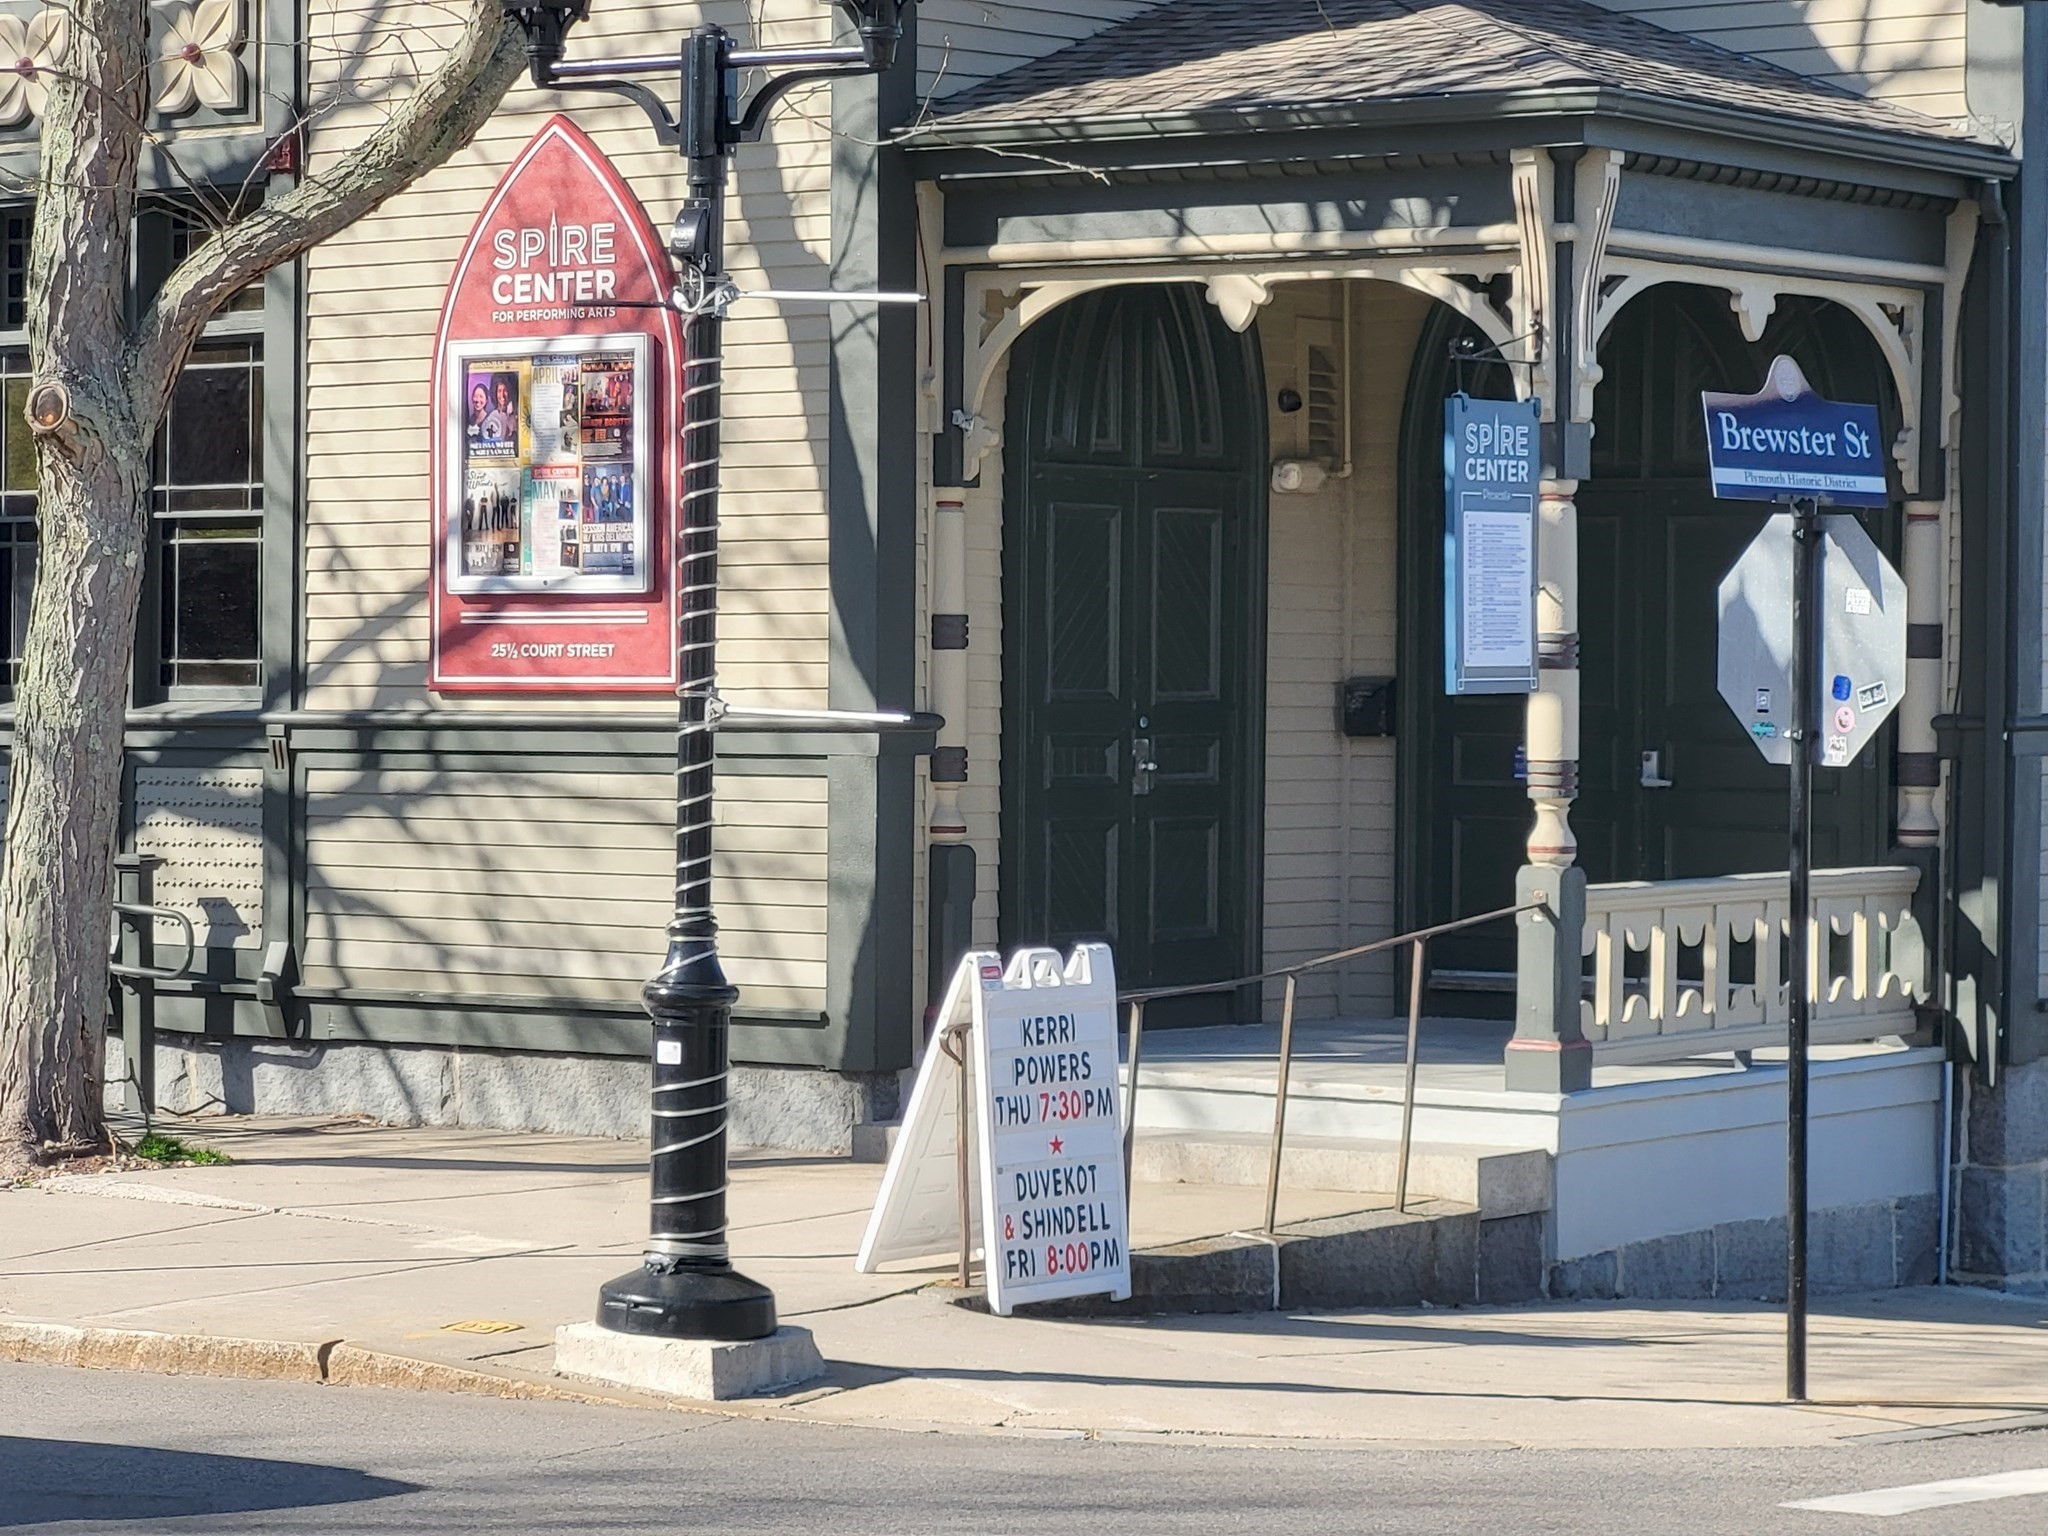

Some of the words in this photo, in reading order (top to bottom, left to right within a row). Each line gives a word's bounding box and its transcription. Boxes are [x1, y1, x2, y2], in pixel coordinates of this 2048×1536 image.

[493, 209, 616, 269] SPIRE
[492, 269, 616, 305] CENTER
[492, 310, 514, 323] FOR
[516, 307, 586, 322] PERFORMING
[588, 305, 616, 318] ARTS
[532, 366, 560, 385] APRIL
[1465, 412, 1529, 456] SPIRE
[1717, 412, 1836, 457] Brewster
[1843, 421, 1872, 459] St
[1465, 457, 1529, 482] CENTER
[1744, 471, 1785, 486] Plymouth
[1787, 473, 1822, 487] Historic
[1824, 476, 1857, 489] District
[532, 480, 557, 499] MAY
[521, 644, 564, 658] COURT
[566, 643, 615, 658] STREET
[1022, 1014, 1076, 1047] KERRI
[1014, 1051, 1092, 1086] POWERS
[995, 1094, 1031, 1126] THU
[1040, 1087, 1113, 1122] 7:30PM
[1015, 1164, 1097, 1201] DUVEKOT
[1004, 1214, 1015, 1240] &
[1022, 1202, 1110, 1240] SHINDELL
[1007, 1249, 1036, 1280] FRI
[1047, 1238, 1119, 1275] 8:00PM
